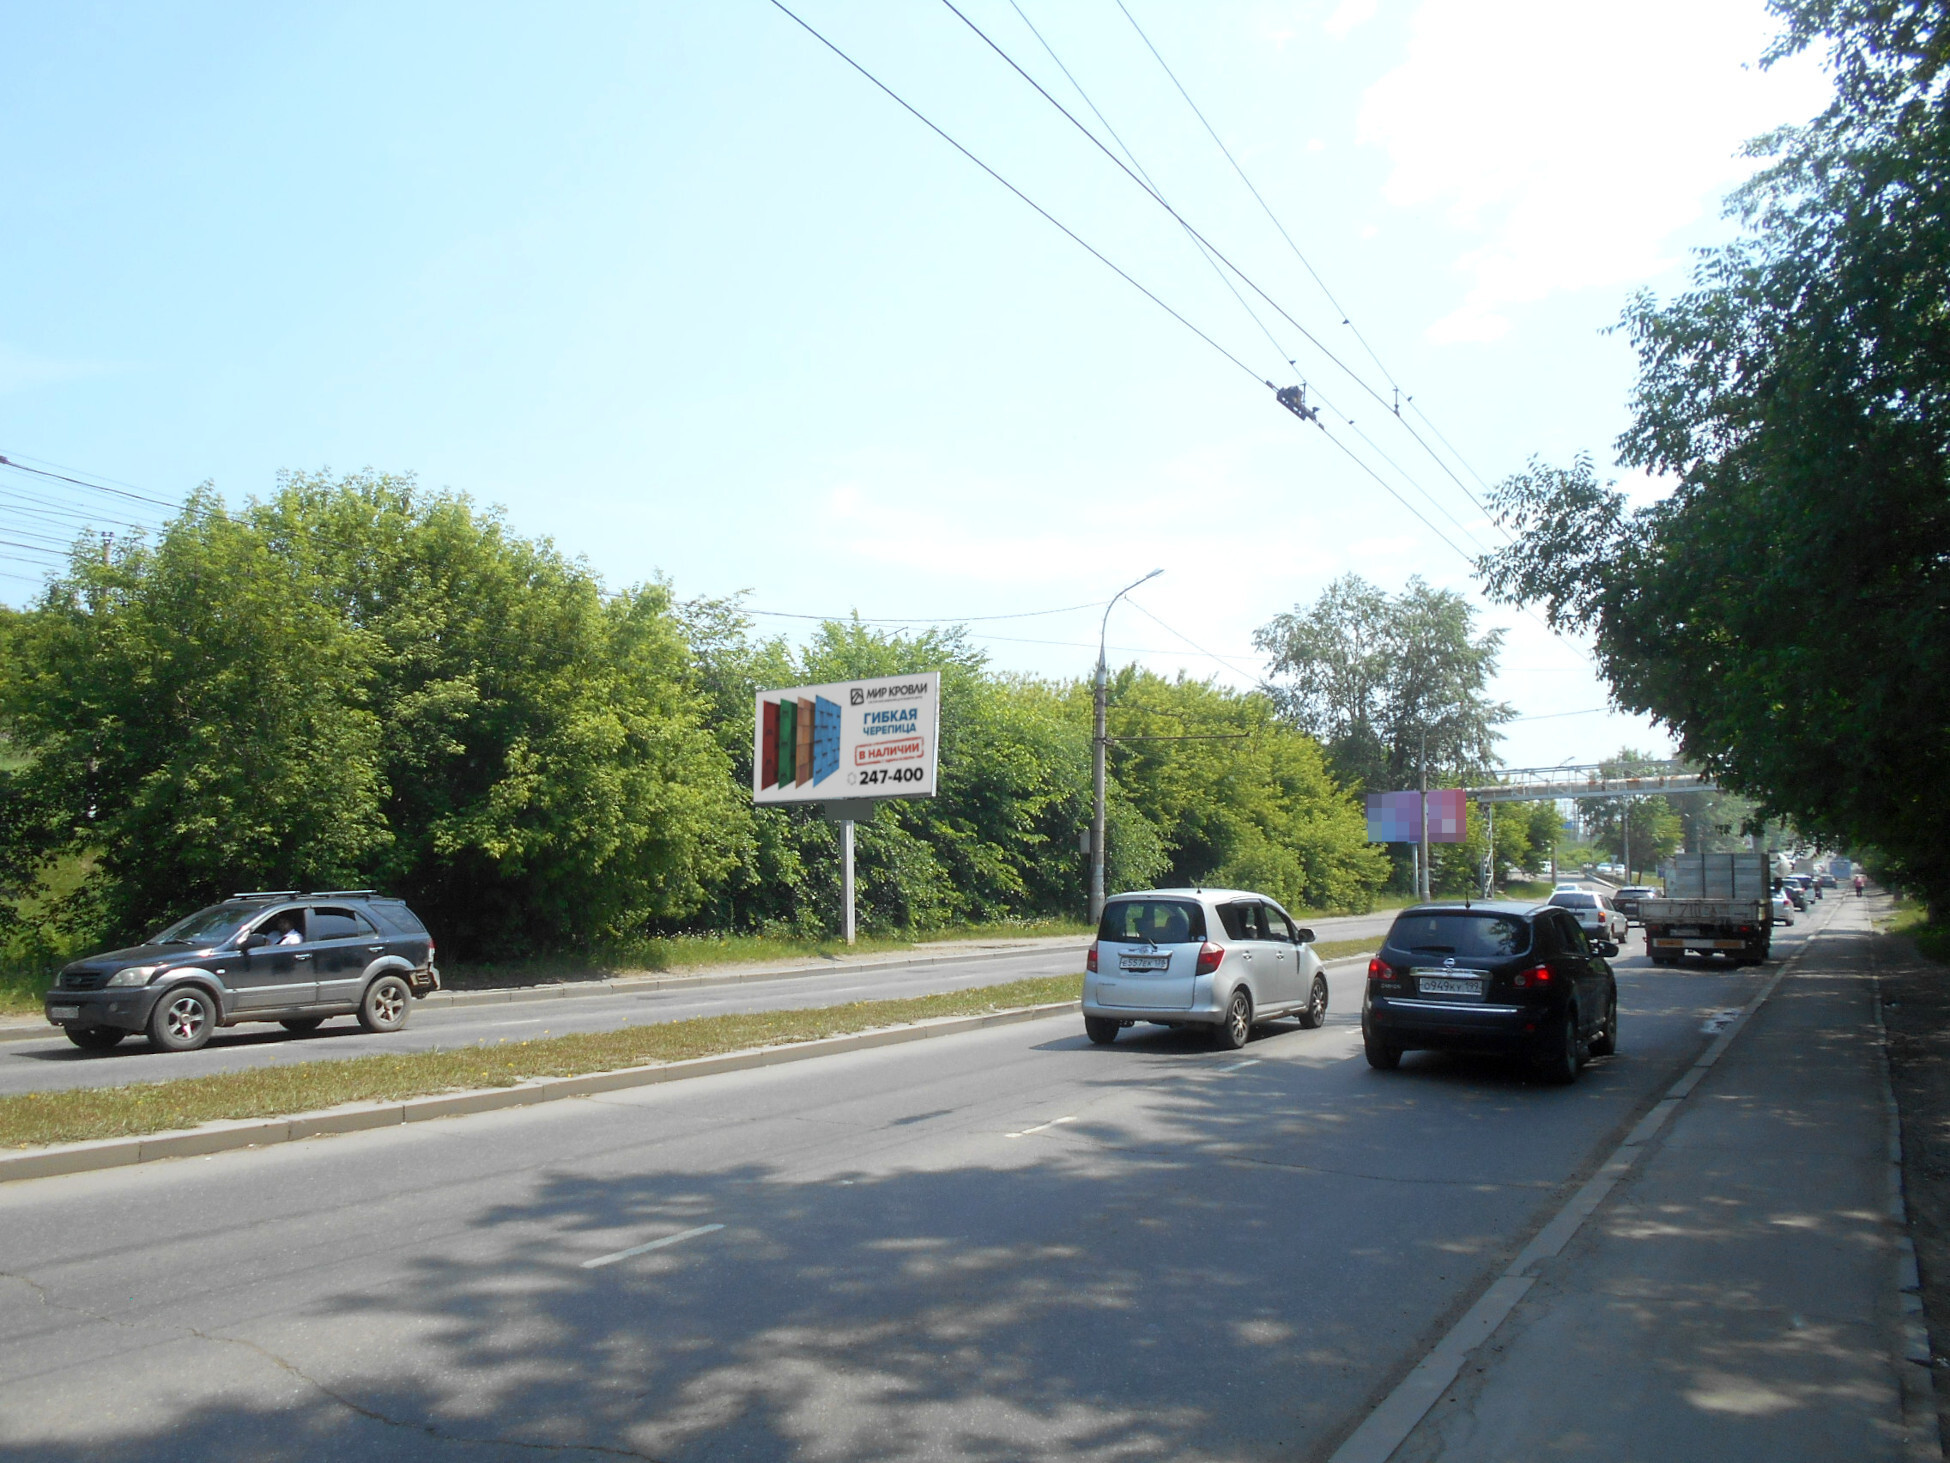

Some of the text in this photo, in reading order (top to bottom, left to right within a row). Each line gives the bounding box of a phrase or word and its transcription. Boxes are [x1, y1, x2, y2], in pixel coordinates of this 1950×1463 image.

[866, 687, 887, 700] МИР
[888, 683, 928, 697] КРОВЛИ
[863, 708, 918, 725] ГИБКАЯ
[863, 723, 916, 736] ЧЕРЕПИЦА
[859, 743, 920, 760] В НАЛИЧИИ
[859, 767, 924, 785] 247-400
